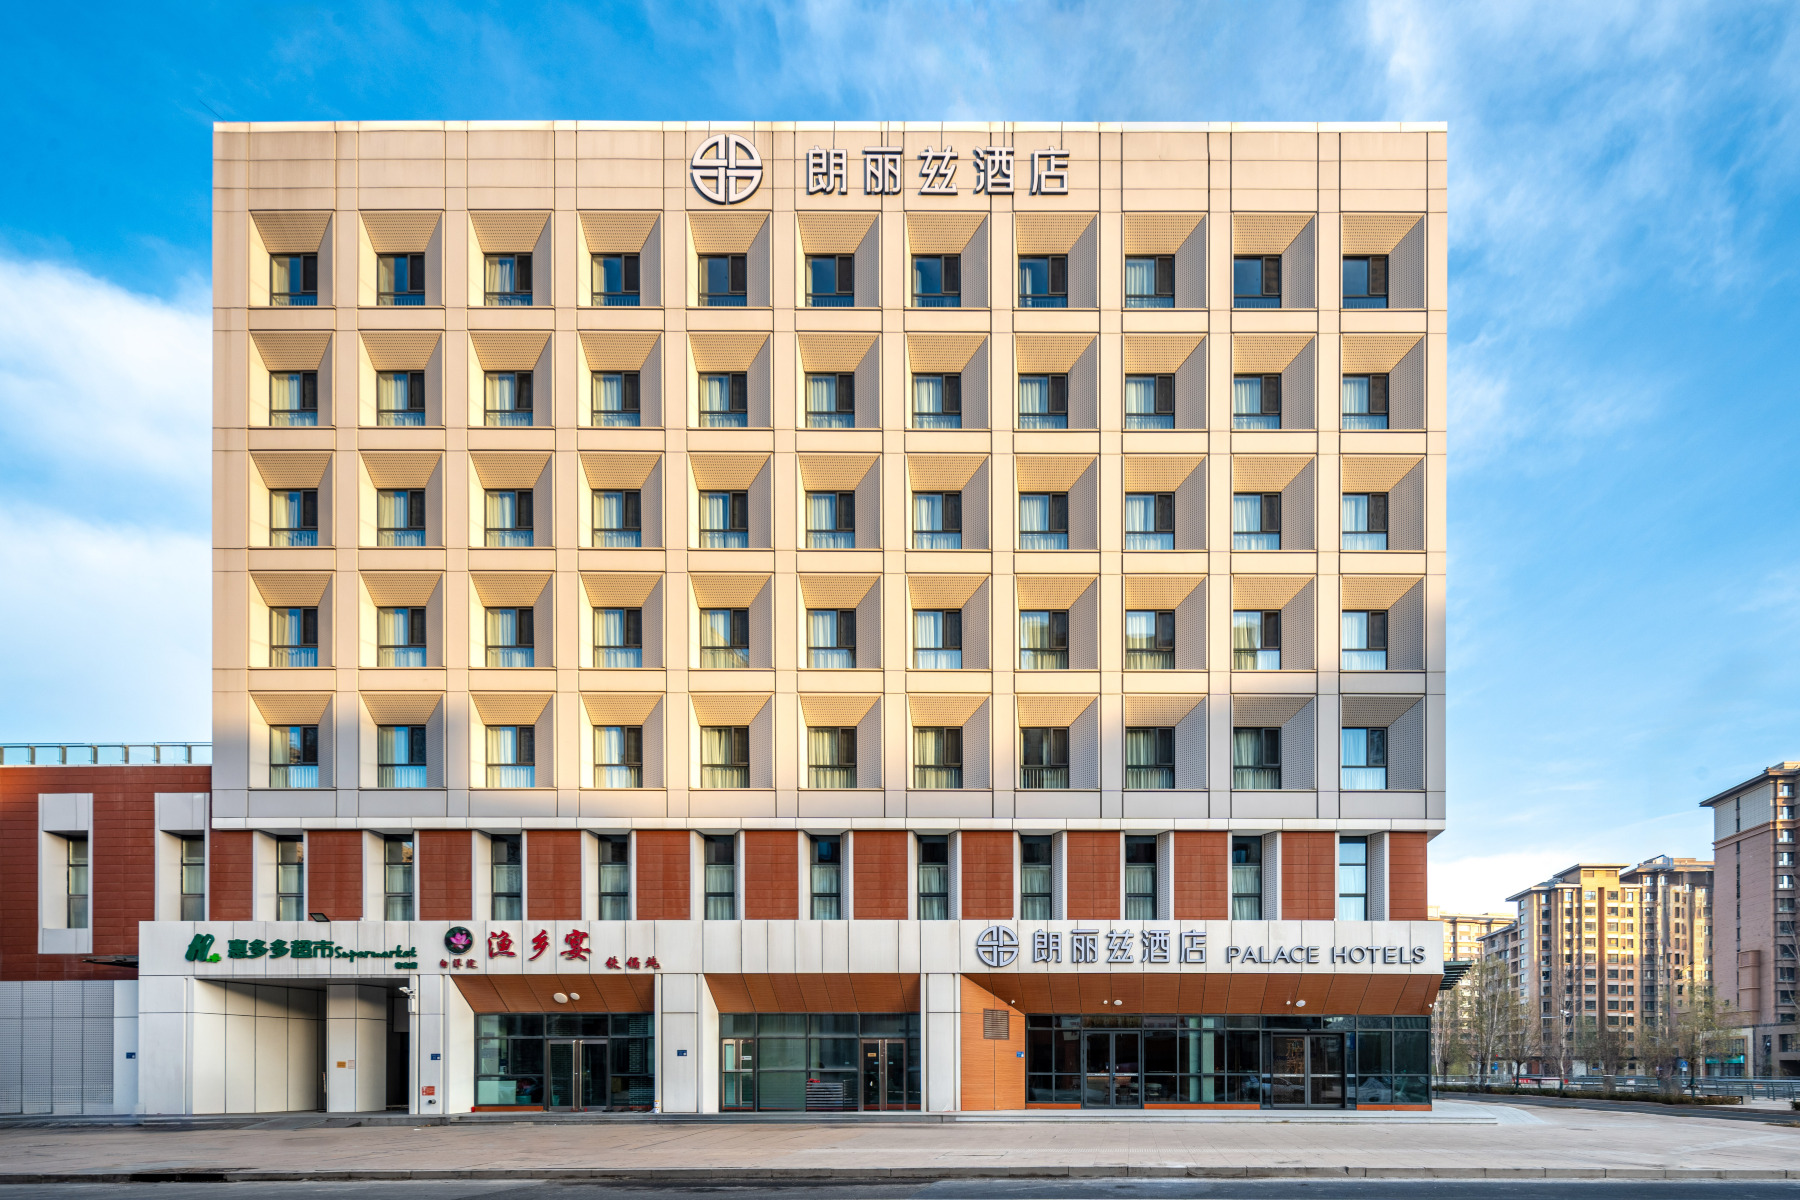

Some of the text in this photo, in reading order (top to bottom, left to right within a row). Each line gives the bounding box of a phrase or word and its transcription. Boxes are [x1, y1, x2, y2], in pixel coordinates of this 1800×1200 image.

[807, 146, 1070, 195] 朗丽兹酒店
[335, 945, 418, 963] Supermarket
[488, 929, 592, 962] 渔乡宴
[1033, 929, 1207, 963] 朗丽兹酒店
[1226, 945, 1427, 964] PALACE HOTELS
